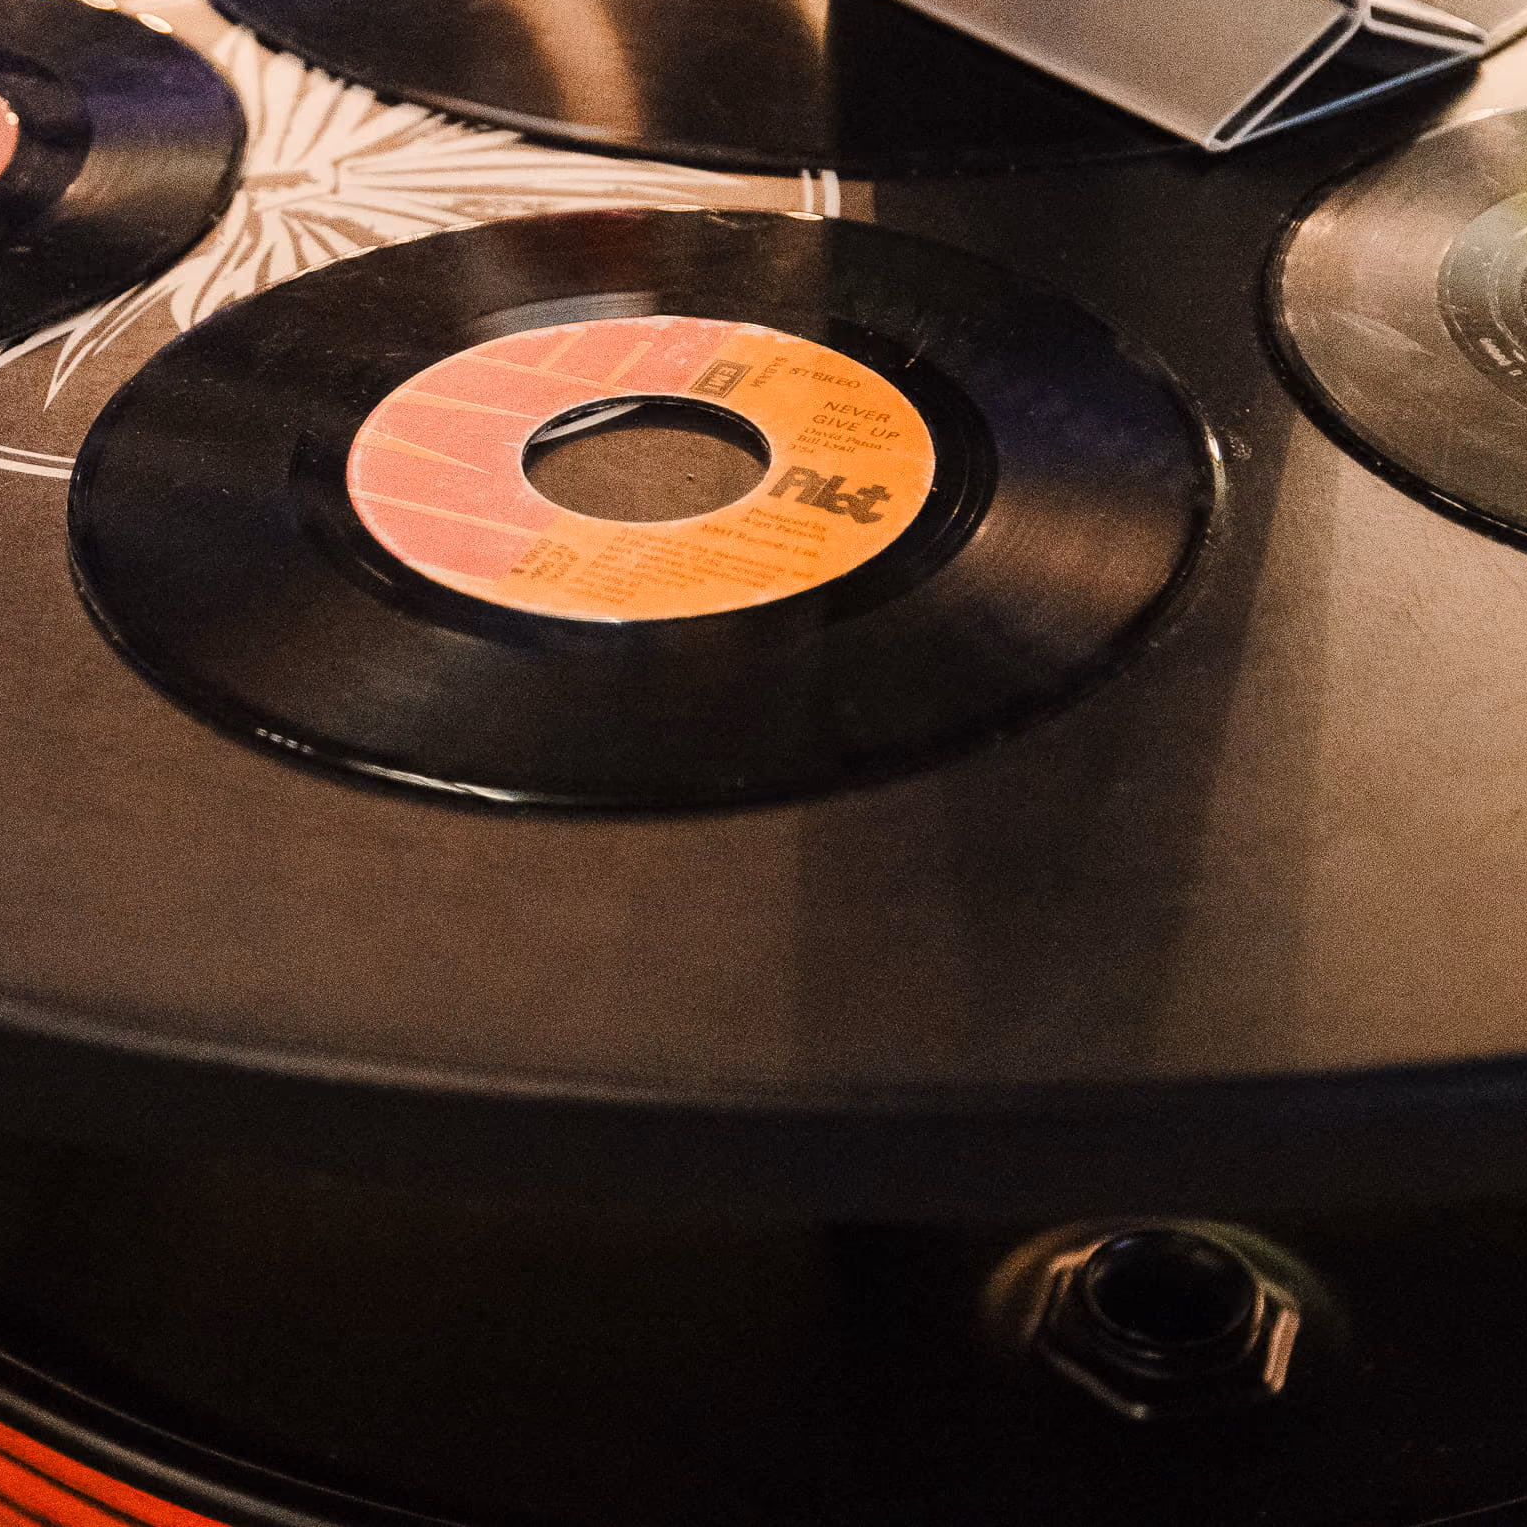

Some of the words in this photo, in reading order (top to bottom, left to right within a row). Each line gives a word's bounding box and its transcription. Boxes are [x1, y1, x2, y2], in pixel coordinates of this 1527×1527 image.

[788, 366, 862, 391] STEREO
[824, 400, 892, 424] NEVER
[812, 414, 858, 433] GIVE
[869, 426, 901, 441] UP
[768, 466, 893, 525] Pilot
